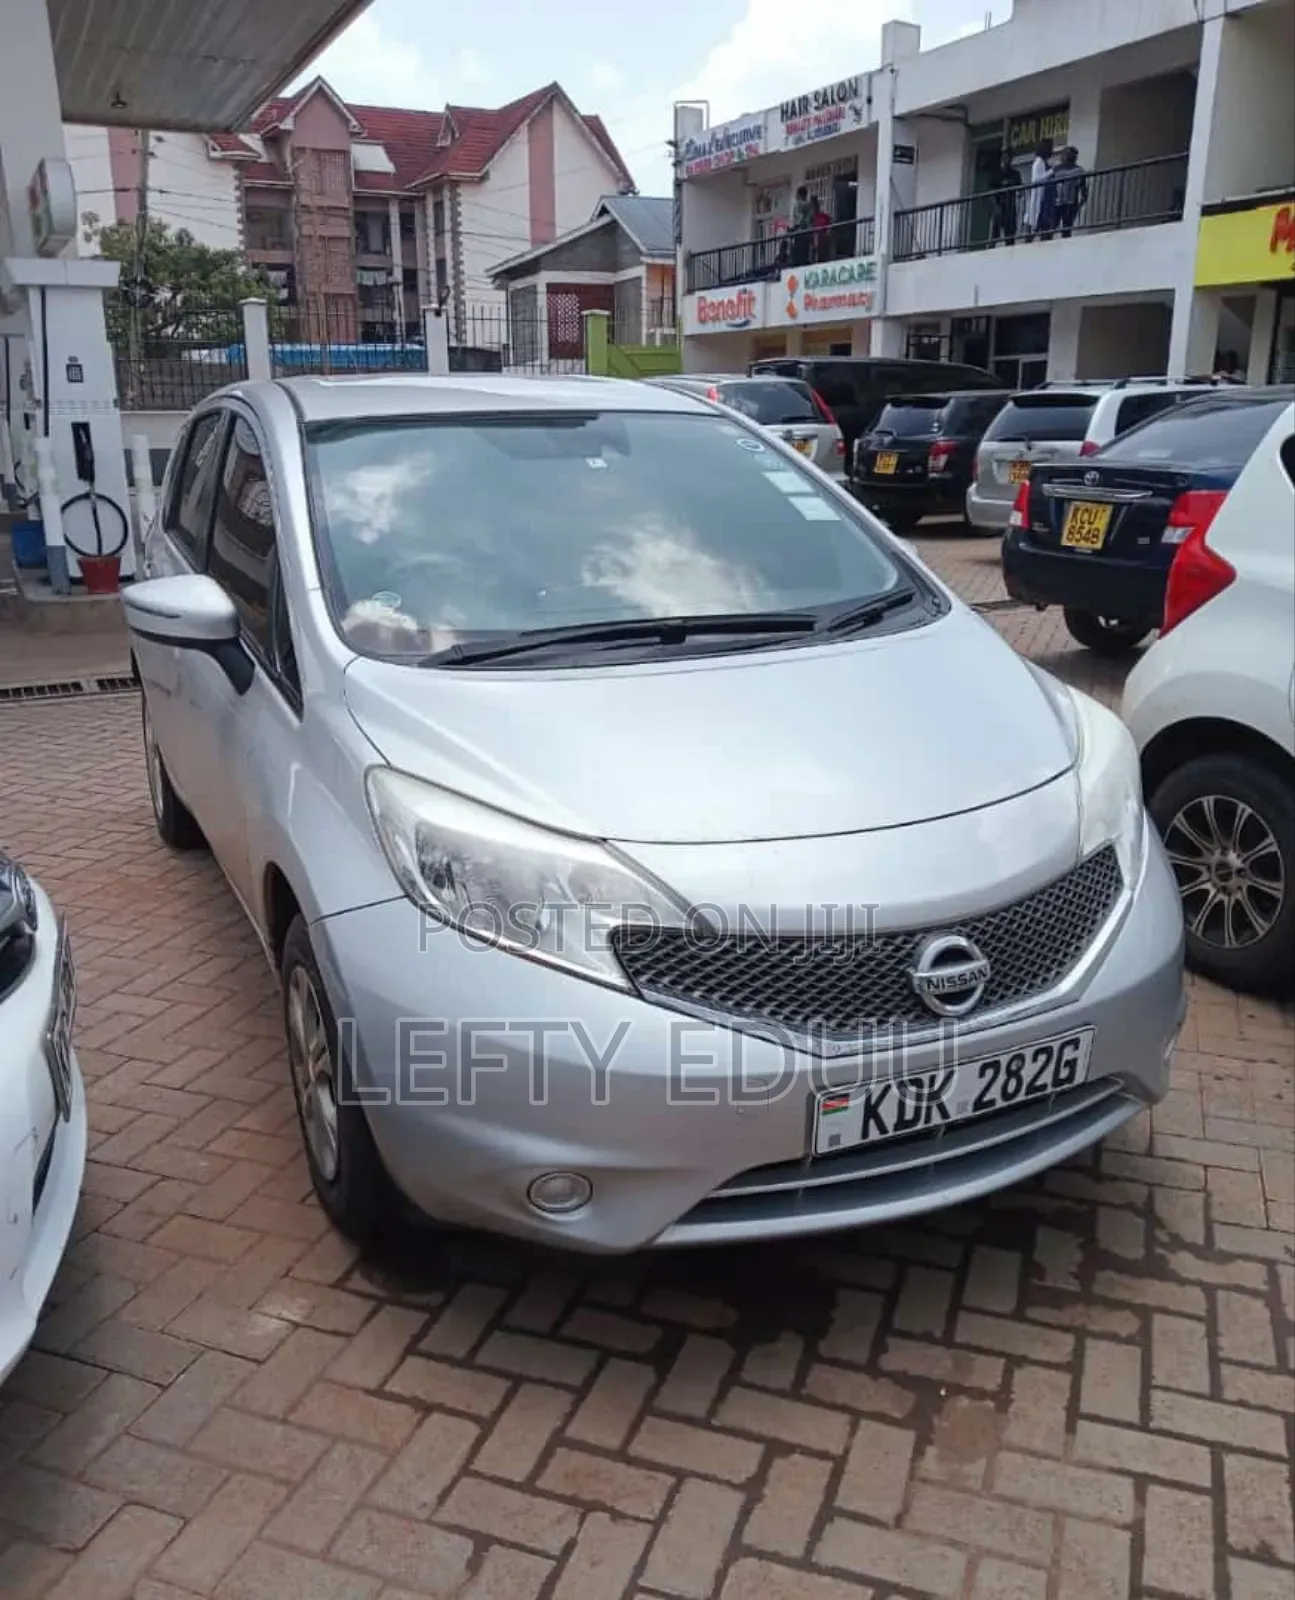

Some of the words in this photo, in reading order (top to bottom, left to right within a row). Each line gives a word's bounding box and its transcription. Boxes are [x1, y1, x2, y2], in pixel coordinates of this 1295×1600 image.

[780, 94, 811, 123] HAIR
[813, 76, 859, 111] SALON
[804, 262, 877, 289] KARACARE
[697, 288, 757, 324] Benefit
[803, 291, 874, 313] Pharmacy
[926, 966, 988, 990] NISSAN
[860, 1069, 956, 1140] KDK
[972, 1037, 1082, 1112] 282G
